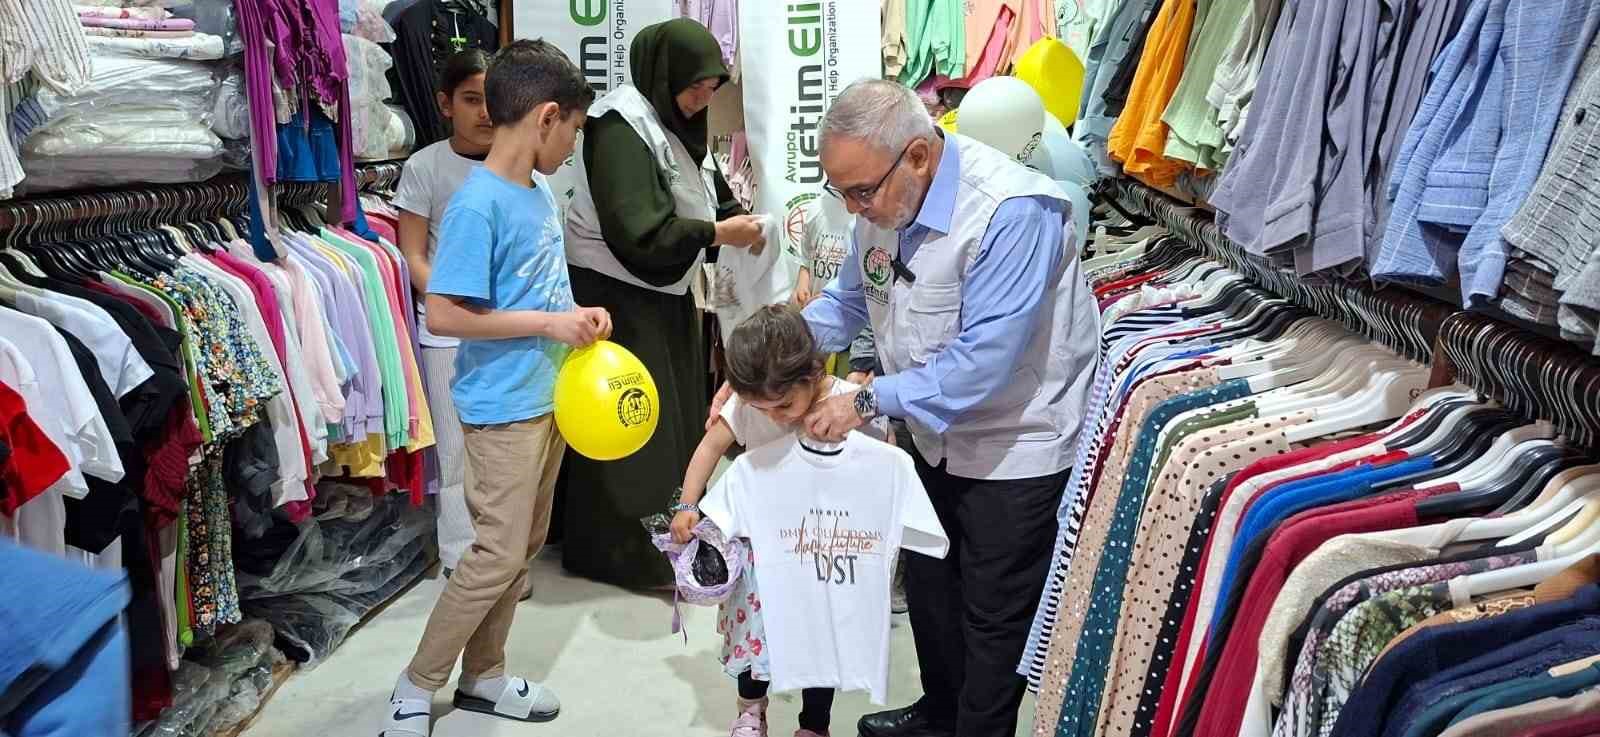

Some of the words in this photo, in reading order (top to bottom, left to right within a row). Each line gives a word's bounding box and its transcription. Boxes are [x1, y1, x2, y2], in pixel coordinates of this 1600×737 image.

[787, 3, 822, 57] Eli
[826, 1, 840, 67] Organization
[613, 44, 626, 68] Help
[828, 70, 840, 92] Help
[785, 131, 798, 183] Avrupa
[813, 552, 858, 585] LOST
